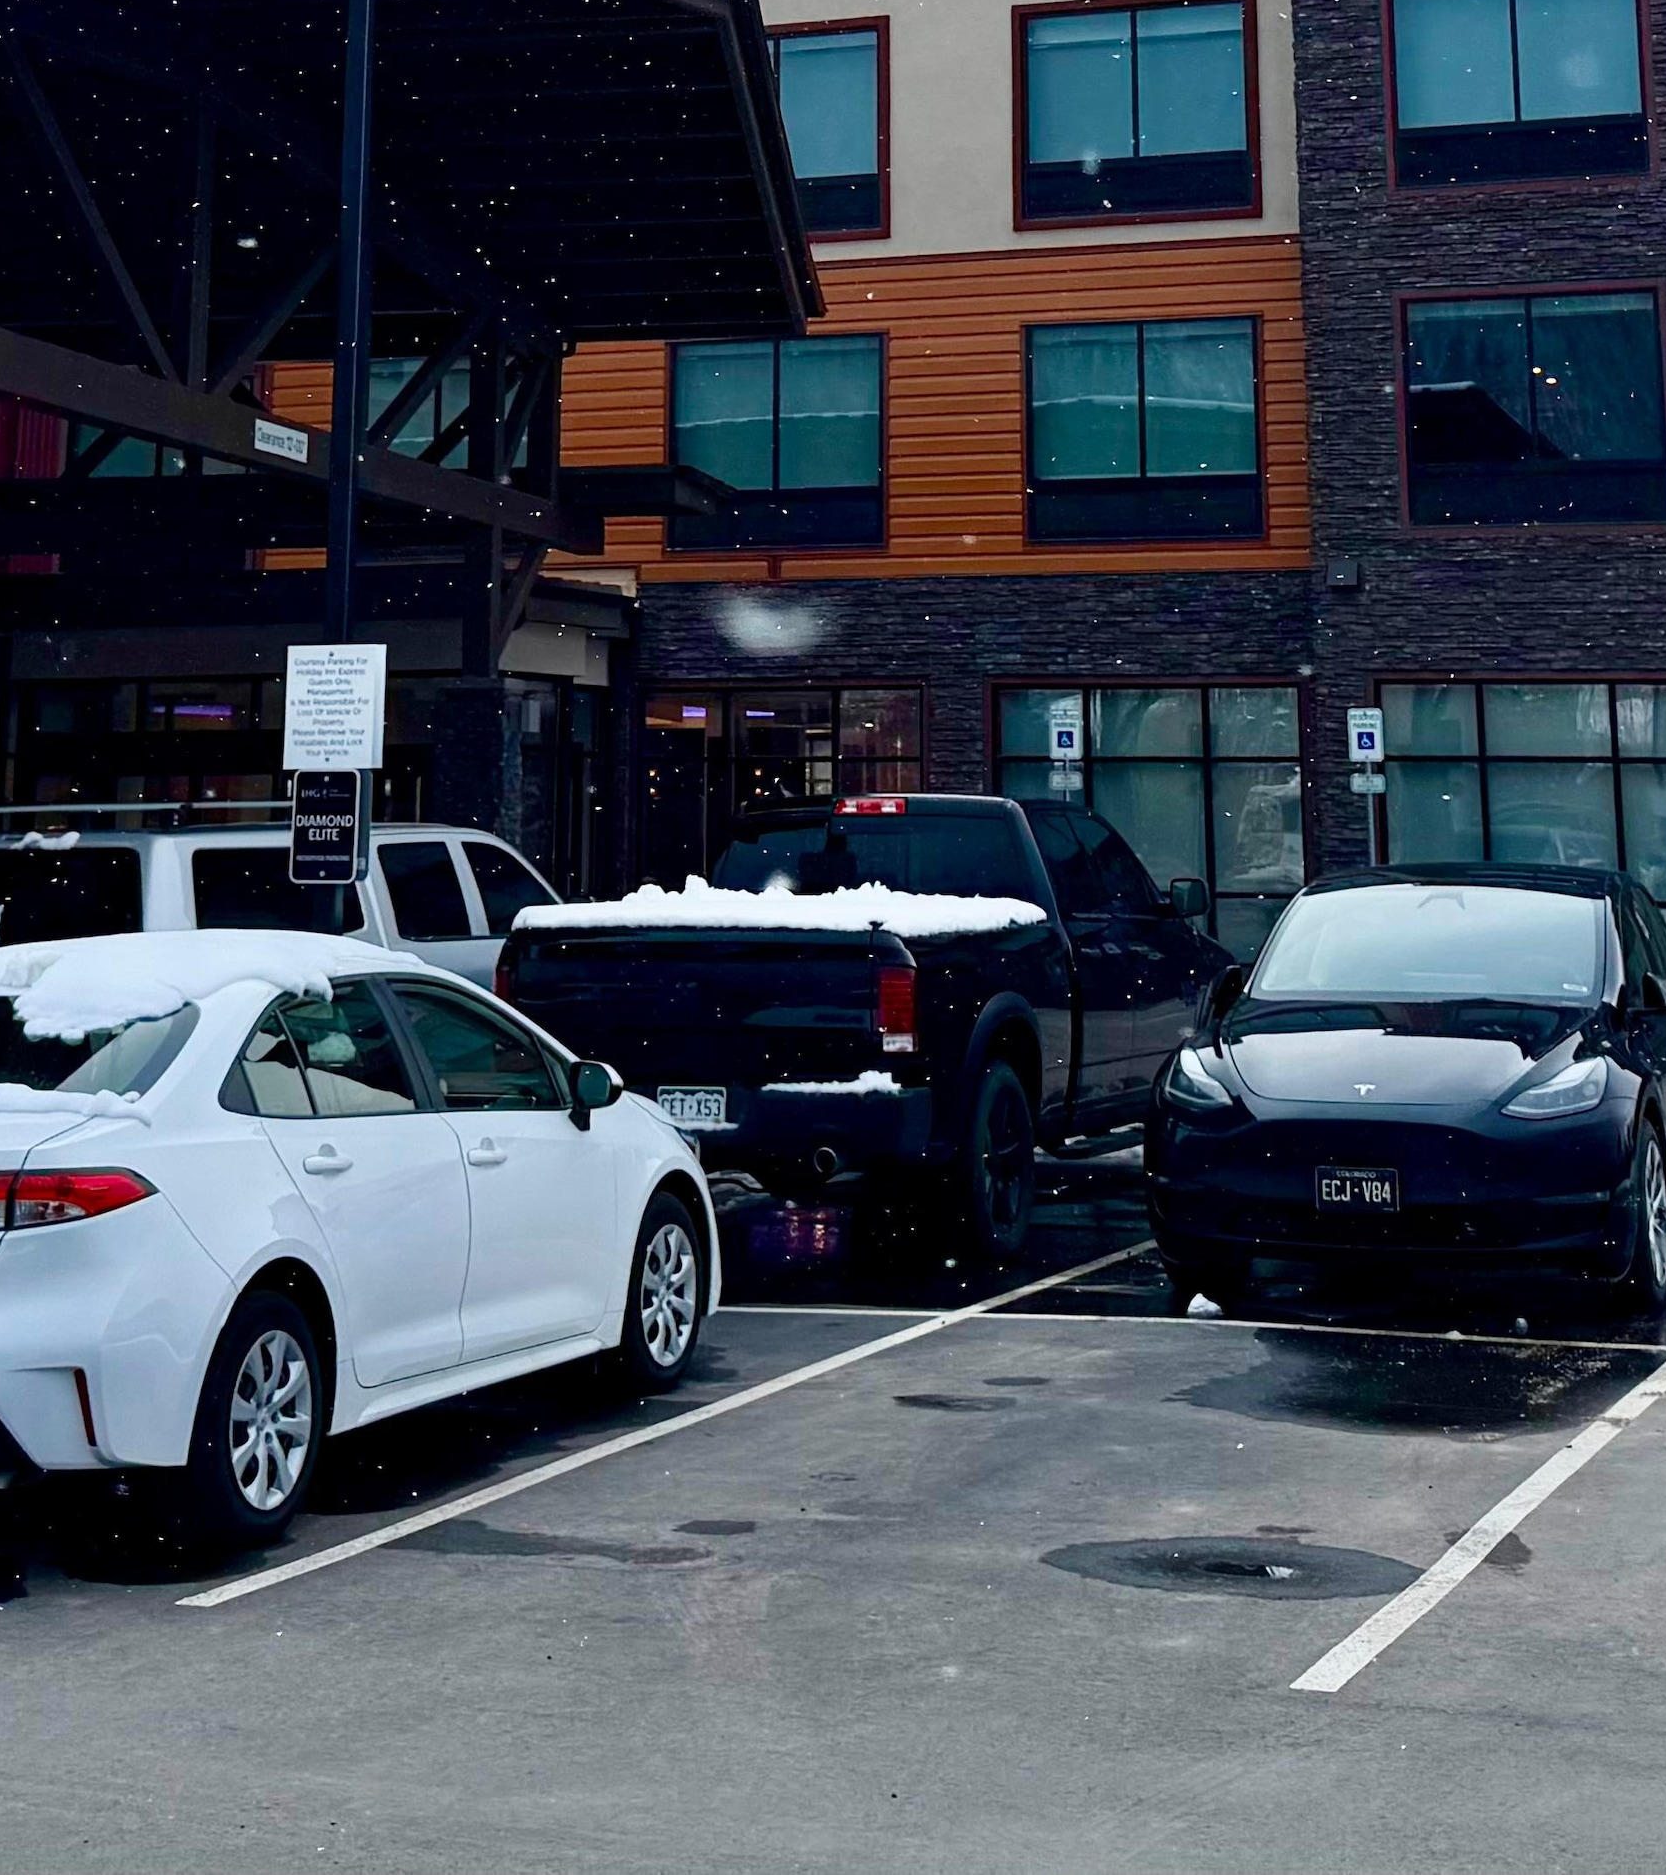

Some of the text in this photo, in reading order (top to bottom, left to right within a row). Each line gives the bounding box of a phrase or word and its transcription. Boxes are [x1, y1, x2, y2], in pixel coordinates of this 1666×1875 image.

[296, 814, 354, 827] DIAMOND
[308, 828, 340, 841] ELITE
[1336, 1170, 1377, 1179] COLORADO
